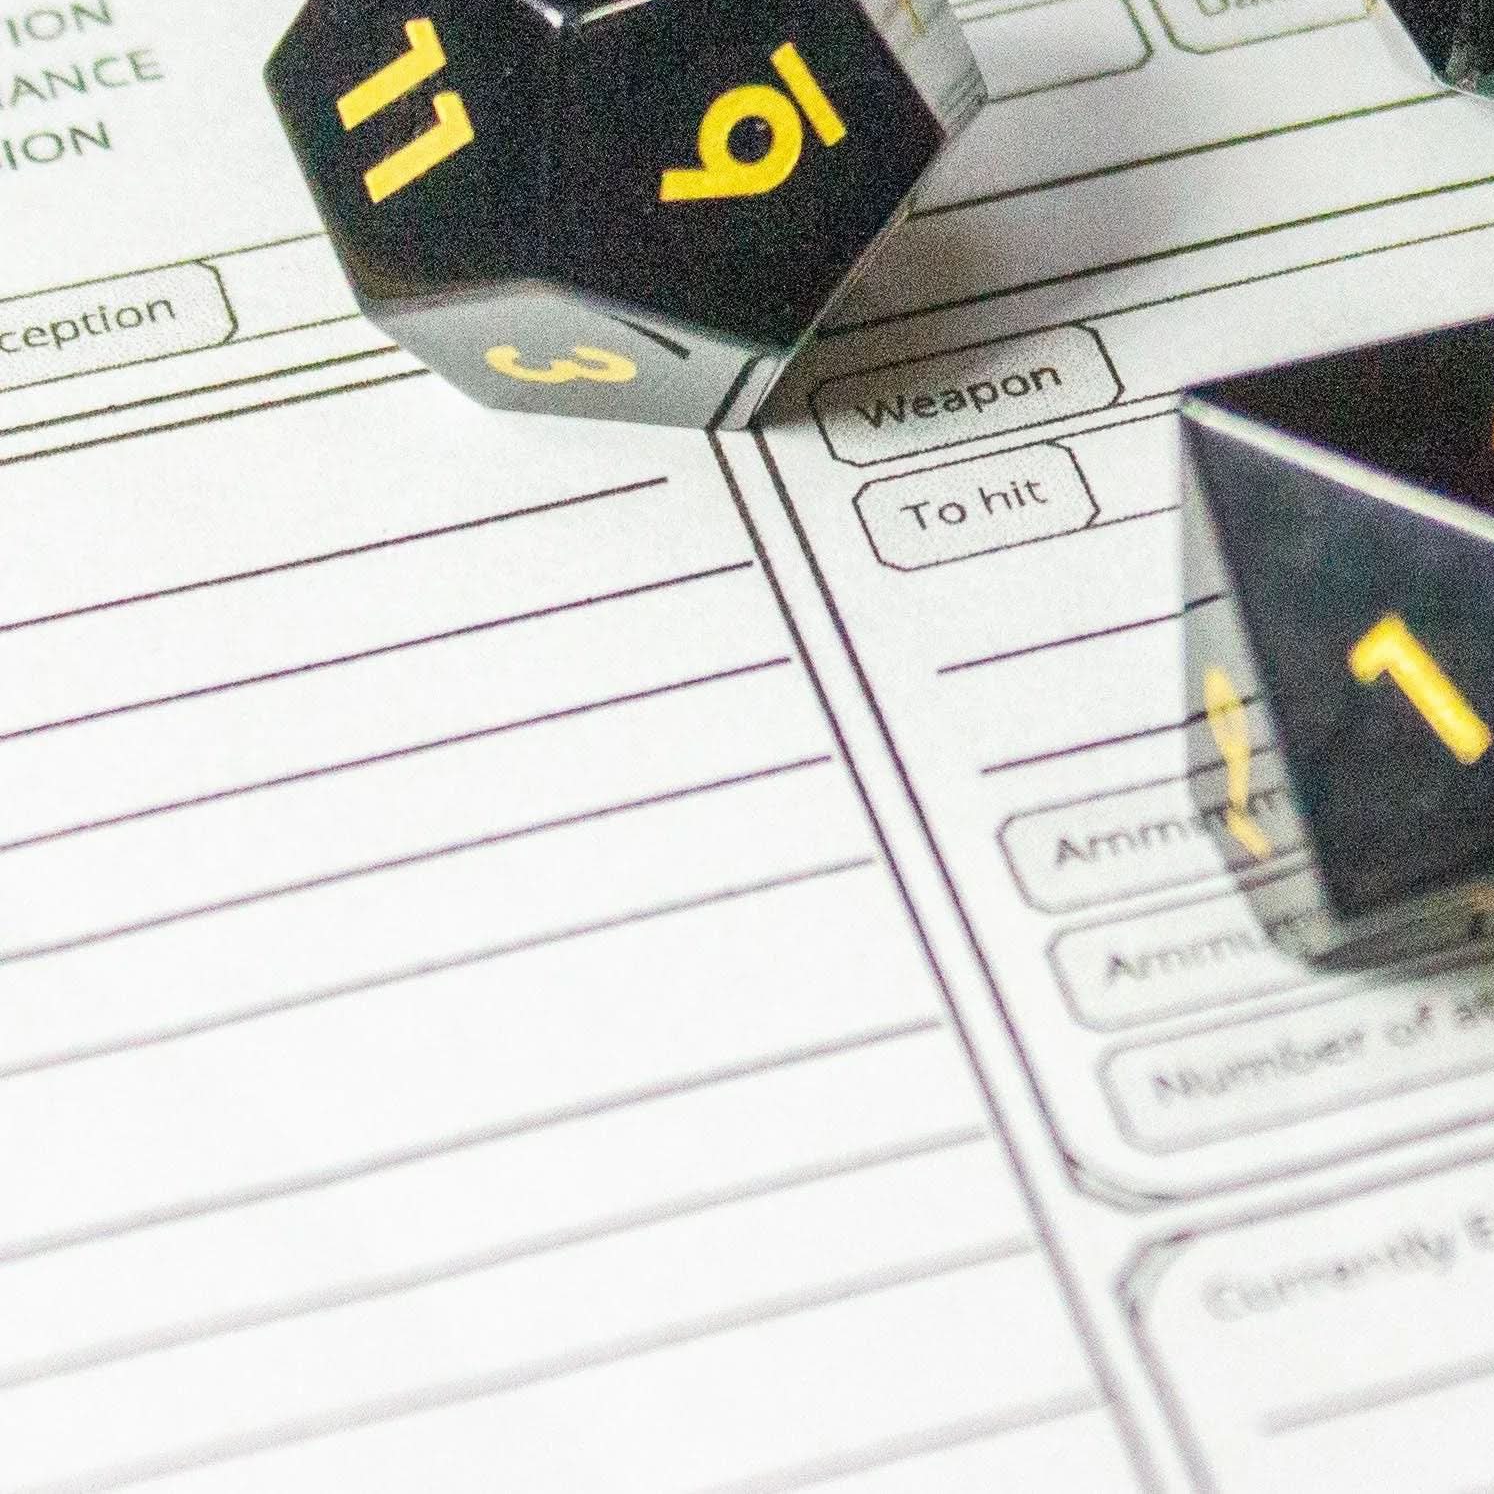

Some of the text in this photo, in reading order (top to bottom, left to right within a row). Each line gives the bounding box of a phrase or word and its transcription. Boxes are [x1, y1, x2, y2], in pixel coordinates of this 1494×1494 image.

[0, 49, 165, 106] ANCE
[336, 17, 475, 203] 11
[0, 299, 176, 352] ception
[486, 345, 637, 384] 3
[855, 363, 1062, 431] Weapon
[900, 477, 1048, 533] To hit
[1348, 614, 1493, 764] 1
[1150, 1029, 1366, 1105] Number
[1386, 1003, 1434, 1048] of
